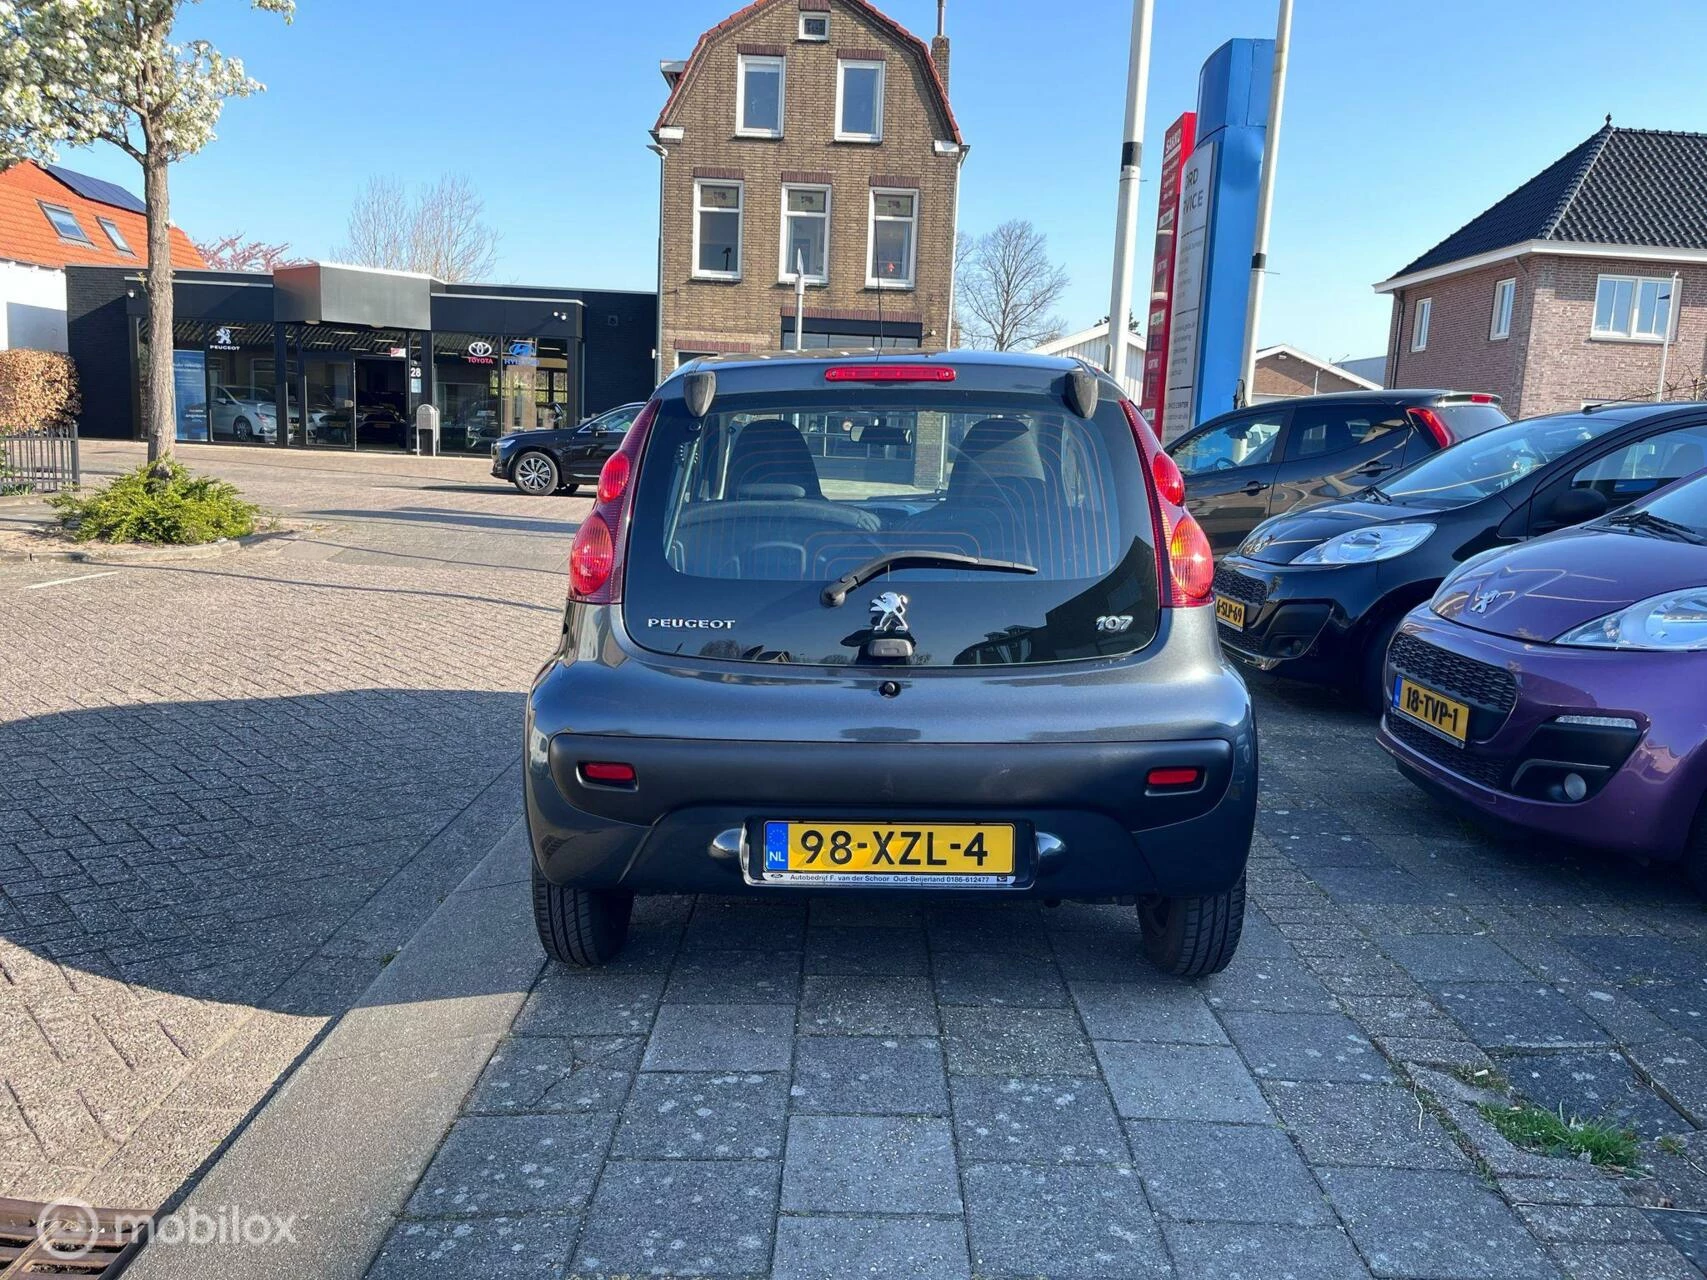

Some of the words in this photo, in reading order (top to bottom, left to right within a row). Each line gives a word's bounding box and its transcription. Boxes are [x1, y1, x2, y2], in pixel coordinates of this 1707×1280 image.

[467, 357, 494, 365] TOYOTA
[410, 367, 422, 378] 28
[647, 618, 736, 629] PEUGEOT
[1096, 615, 1134, 632] 107
[1406, 686, 1459, 733] 18-TVP-1
[800, 829, 989, 867] 98-XZL-4
[768, 850, 786, 863] NL
[790, 874, 829, 882] Autobedrijf
[892, 875, 945, 883] Oud-Beijerland
